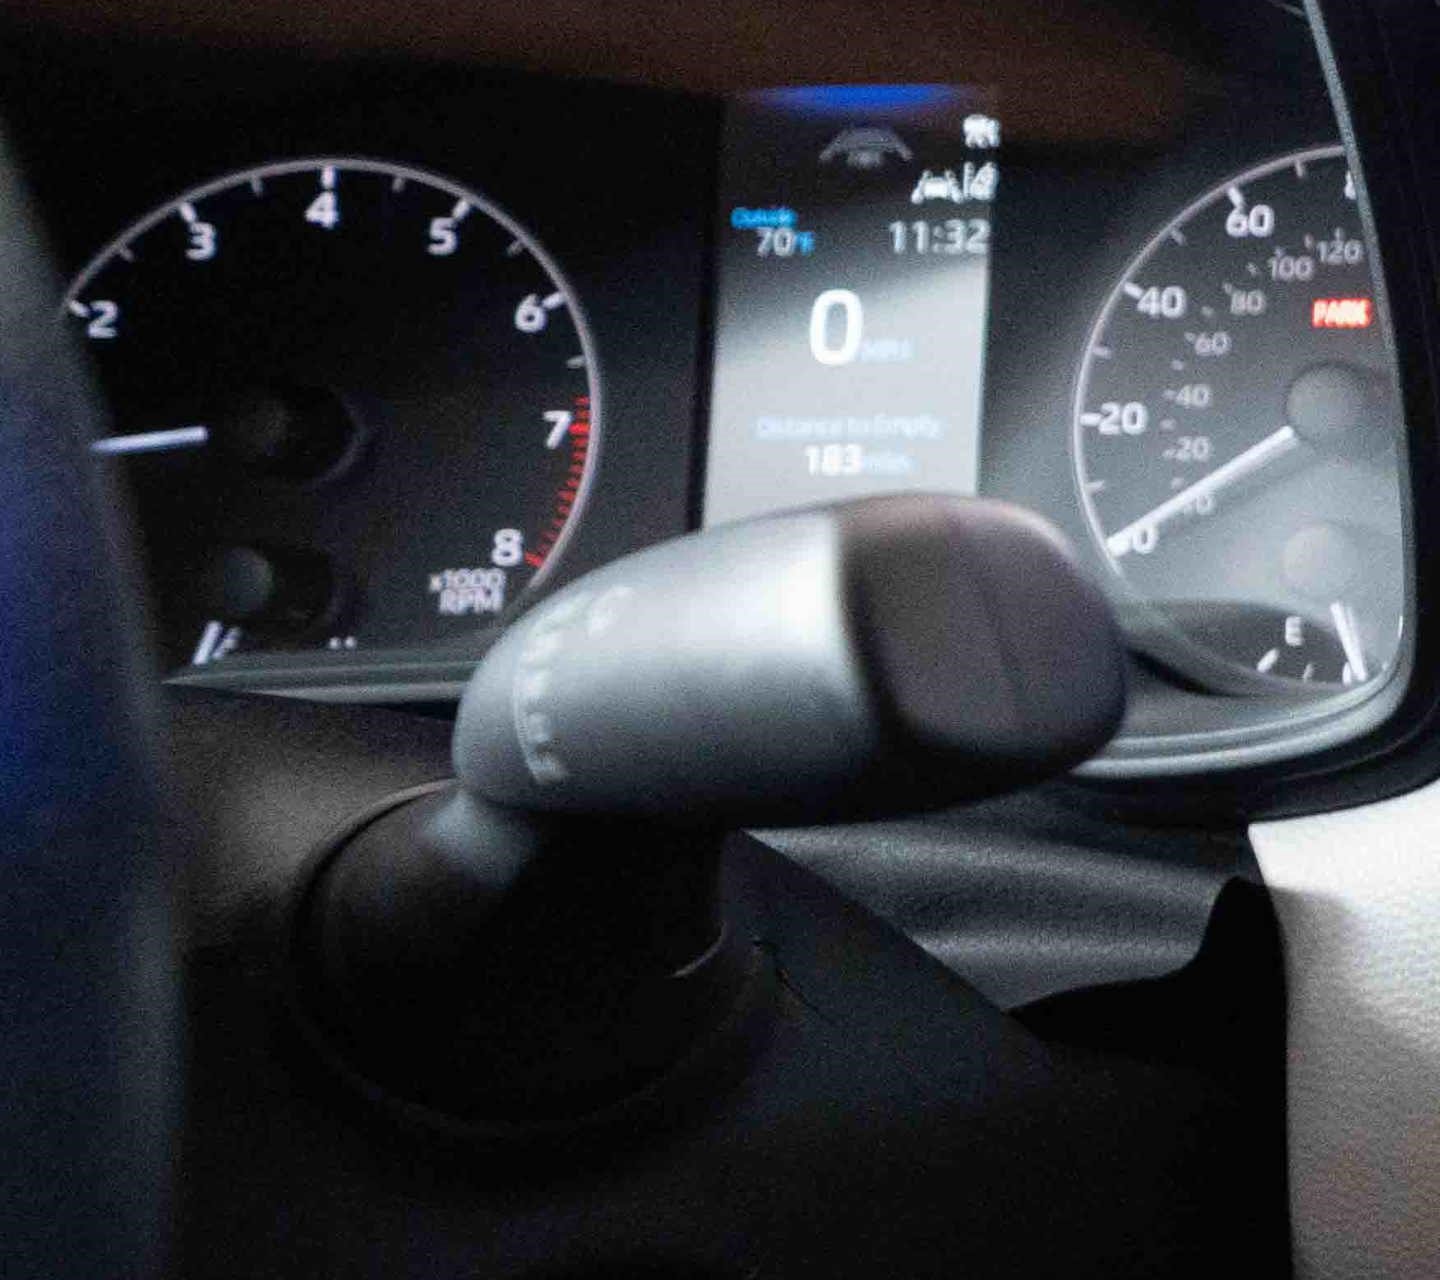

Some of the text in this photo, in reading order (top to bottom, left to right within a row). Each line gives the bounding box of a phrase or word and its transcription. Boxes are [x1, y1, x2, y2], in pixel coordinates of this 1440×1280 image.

[305, 191, 338, 228] 4
[1225, 205, 1274, 238] 60
[185, 223, 216, 261] 3
[428, 217, 457, 255] 5
[889, 219, 990, 254] 11:32
[1317, 237, 1362, 265] 120
[1268, 253, 1314, 281] 100
[514, 295, 546, 332] 6
[1137, 285, 1185, 317] 40
[1230, 288, 1266, 316] 80
[88, 301, 117, 338] 2
[809, 288, 863, 366] 0
[1195, 331, 1231, 355] 60
[1175, 384, 1211, 408] 40
[543, 409, 571, 449] 7
[1099, 402, 1146, 436] 20
[804, 444, 863, 476] 183
[1175, 437, 1210, 462] 20
[492, 529, 523, 567] 8
[1285, 616, 1303, 647] E
